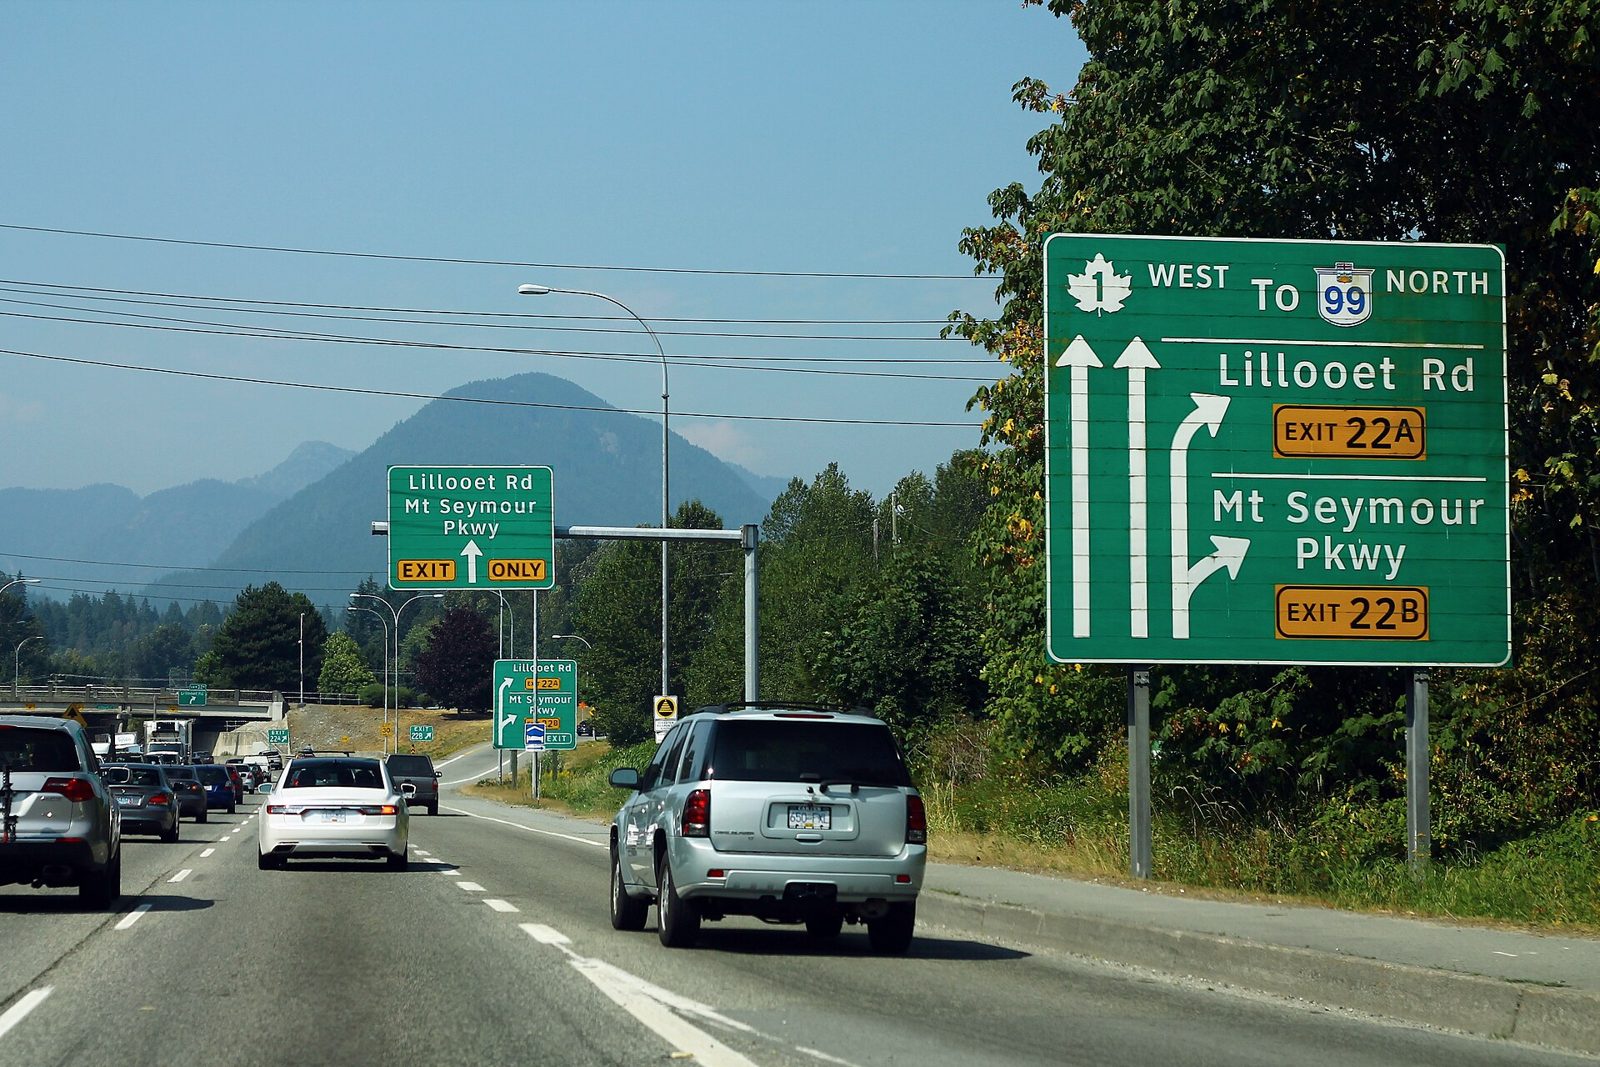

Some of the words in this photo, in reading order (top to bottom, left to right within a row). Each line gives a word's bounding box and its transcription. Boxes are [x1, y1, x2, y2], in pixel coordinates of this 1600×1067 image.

[1092, 270, 1104, 302] 1
[1148, 263, 1230, 289] WEST
[1251, 278, 1301, 313] To
[1324, 285, 1366, 315] 99
[1387, 269, 1489, 295] NORTH
[1219, 350, 1396, 391] Lillooet
[1423, 356, 1475, 392] Rd
[1285, 423, 1337, 442] EXIT
[1346, 416, 1417, 450] 22A
[409, 473, 497, 490] Lillooet
[506, 474, 533, 490] Rd
[405, 498, 430, 514] Mt
[440, 499, 537, 518] Seymour
[1213, 490, 1265, 523] Mt
[1287, 491, 1485, 533] Seymour
[444, 520, 500, 540] Pkwy
[1296, 536, 1408, 581] Pkwy
[403, 563, 451, 578] EXIT
[491, 562, 542, 577] ONLY
[1287, 602, 1342, 623] EXIT
[1349, 597, 1420, 631] 22B
[558, 663, 572, 672] Rd
[541, 680, 559, 688] 22A
[509, 696, 522, 704] Mt
[526, 696, 572, 706] Symour
